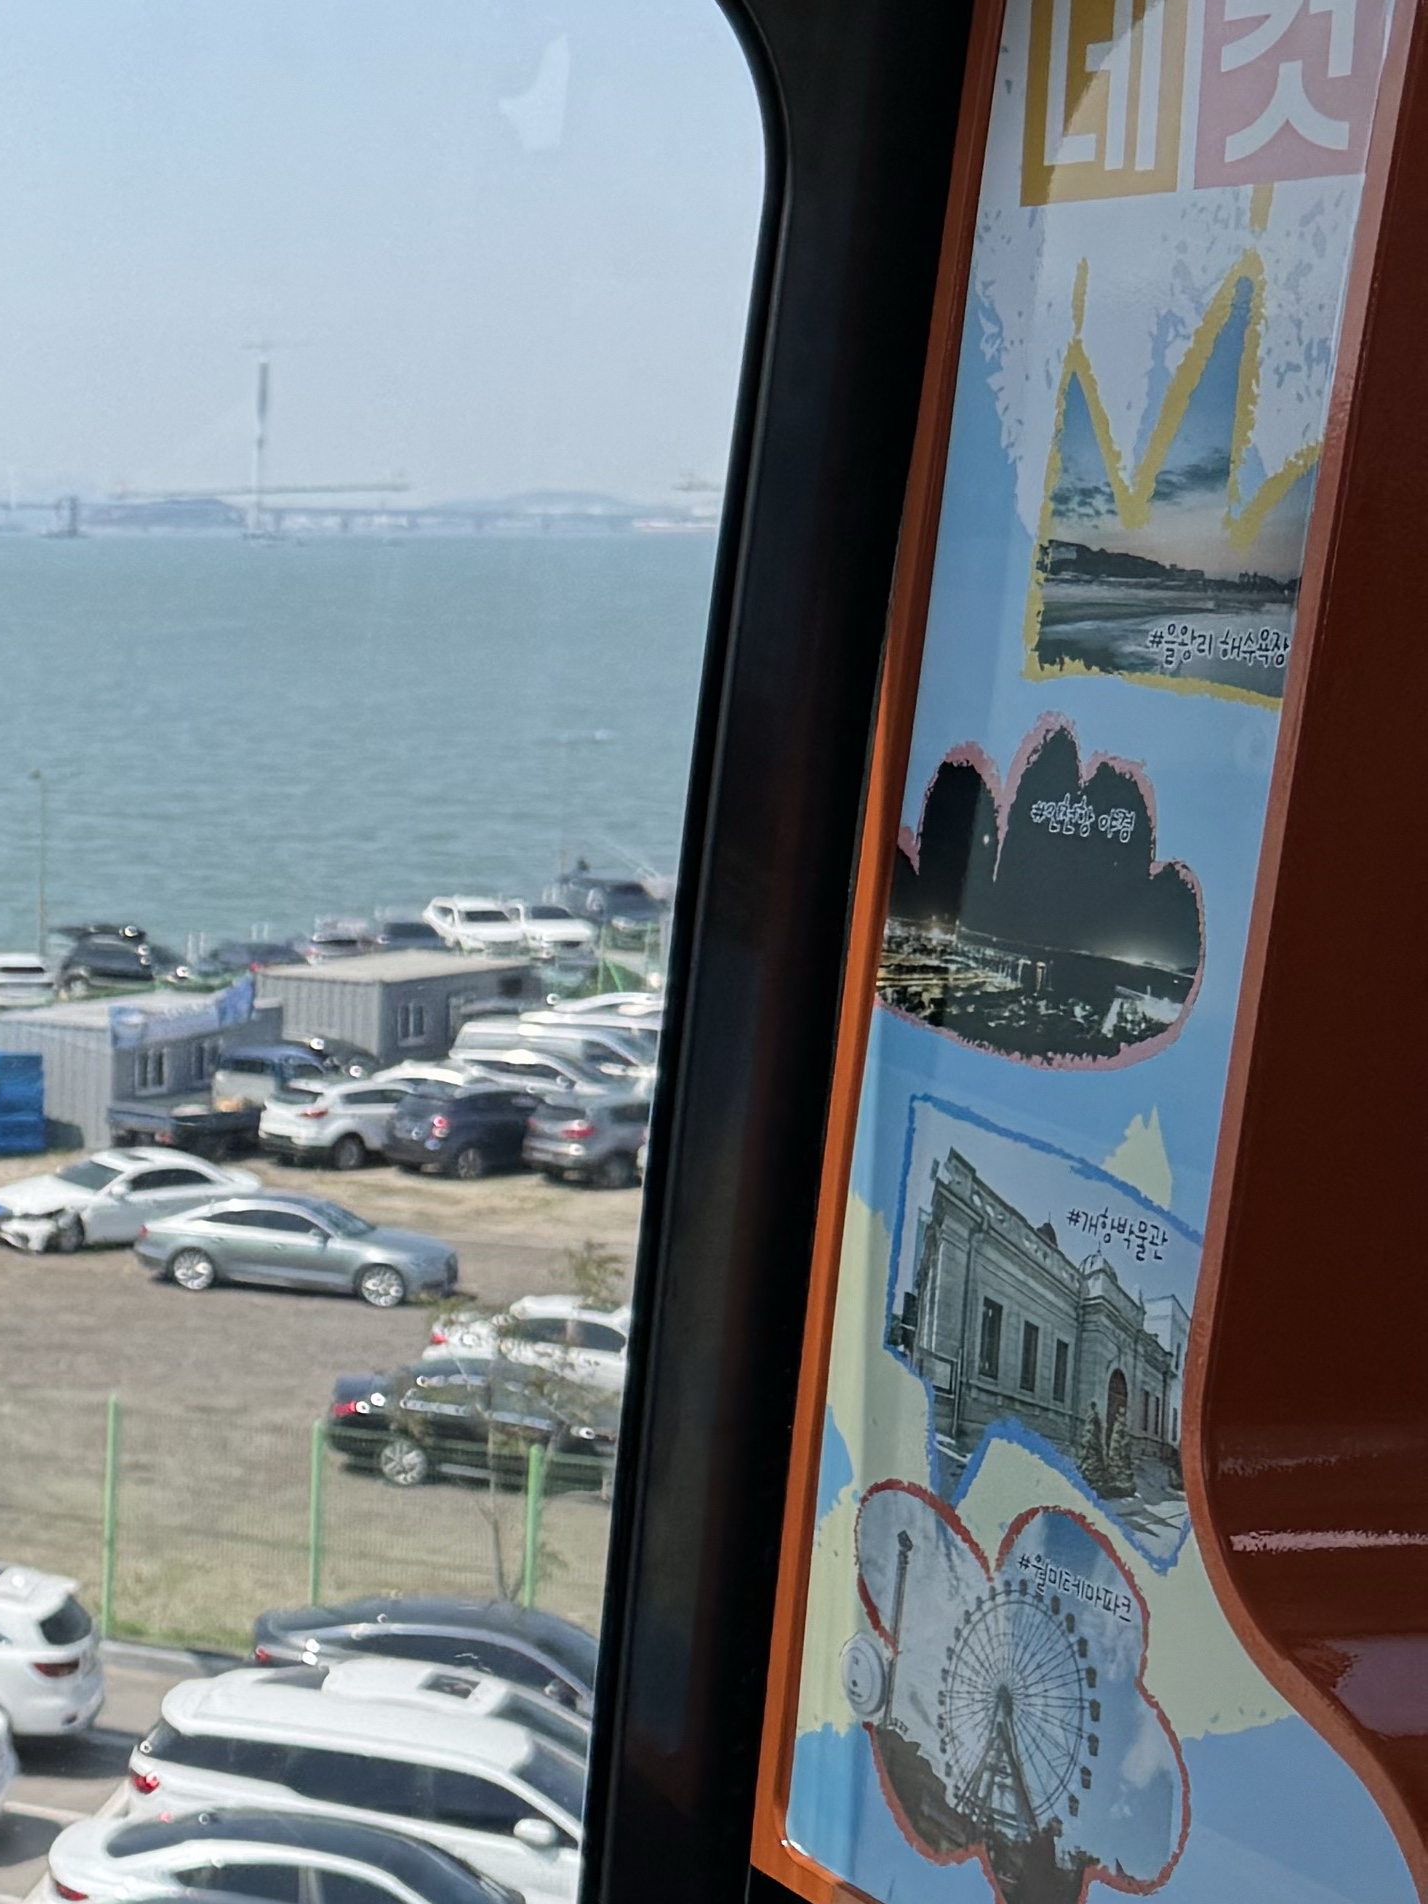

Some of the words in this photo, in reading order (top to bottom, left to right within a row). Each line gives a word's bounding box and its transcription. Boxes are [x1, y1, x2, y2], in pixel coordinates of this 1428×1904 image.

[1149, 623, 1213, 666] #을왕리
[1218, 628, 1290, 666] 해수욕장
[1030, 792, 1095, 837] #인천항
[1098, 808, 1135, 843] 야경
[1066, 1206, 1169, 1262] #개항박물관
[1017, 1553, 1132, 1623] #월미테마파크
